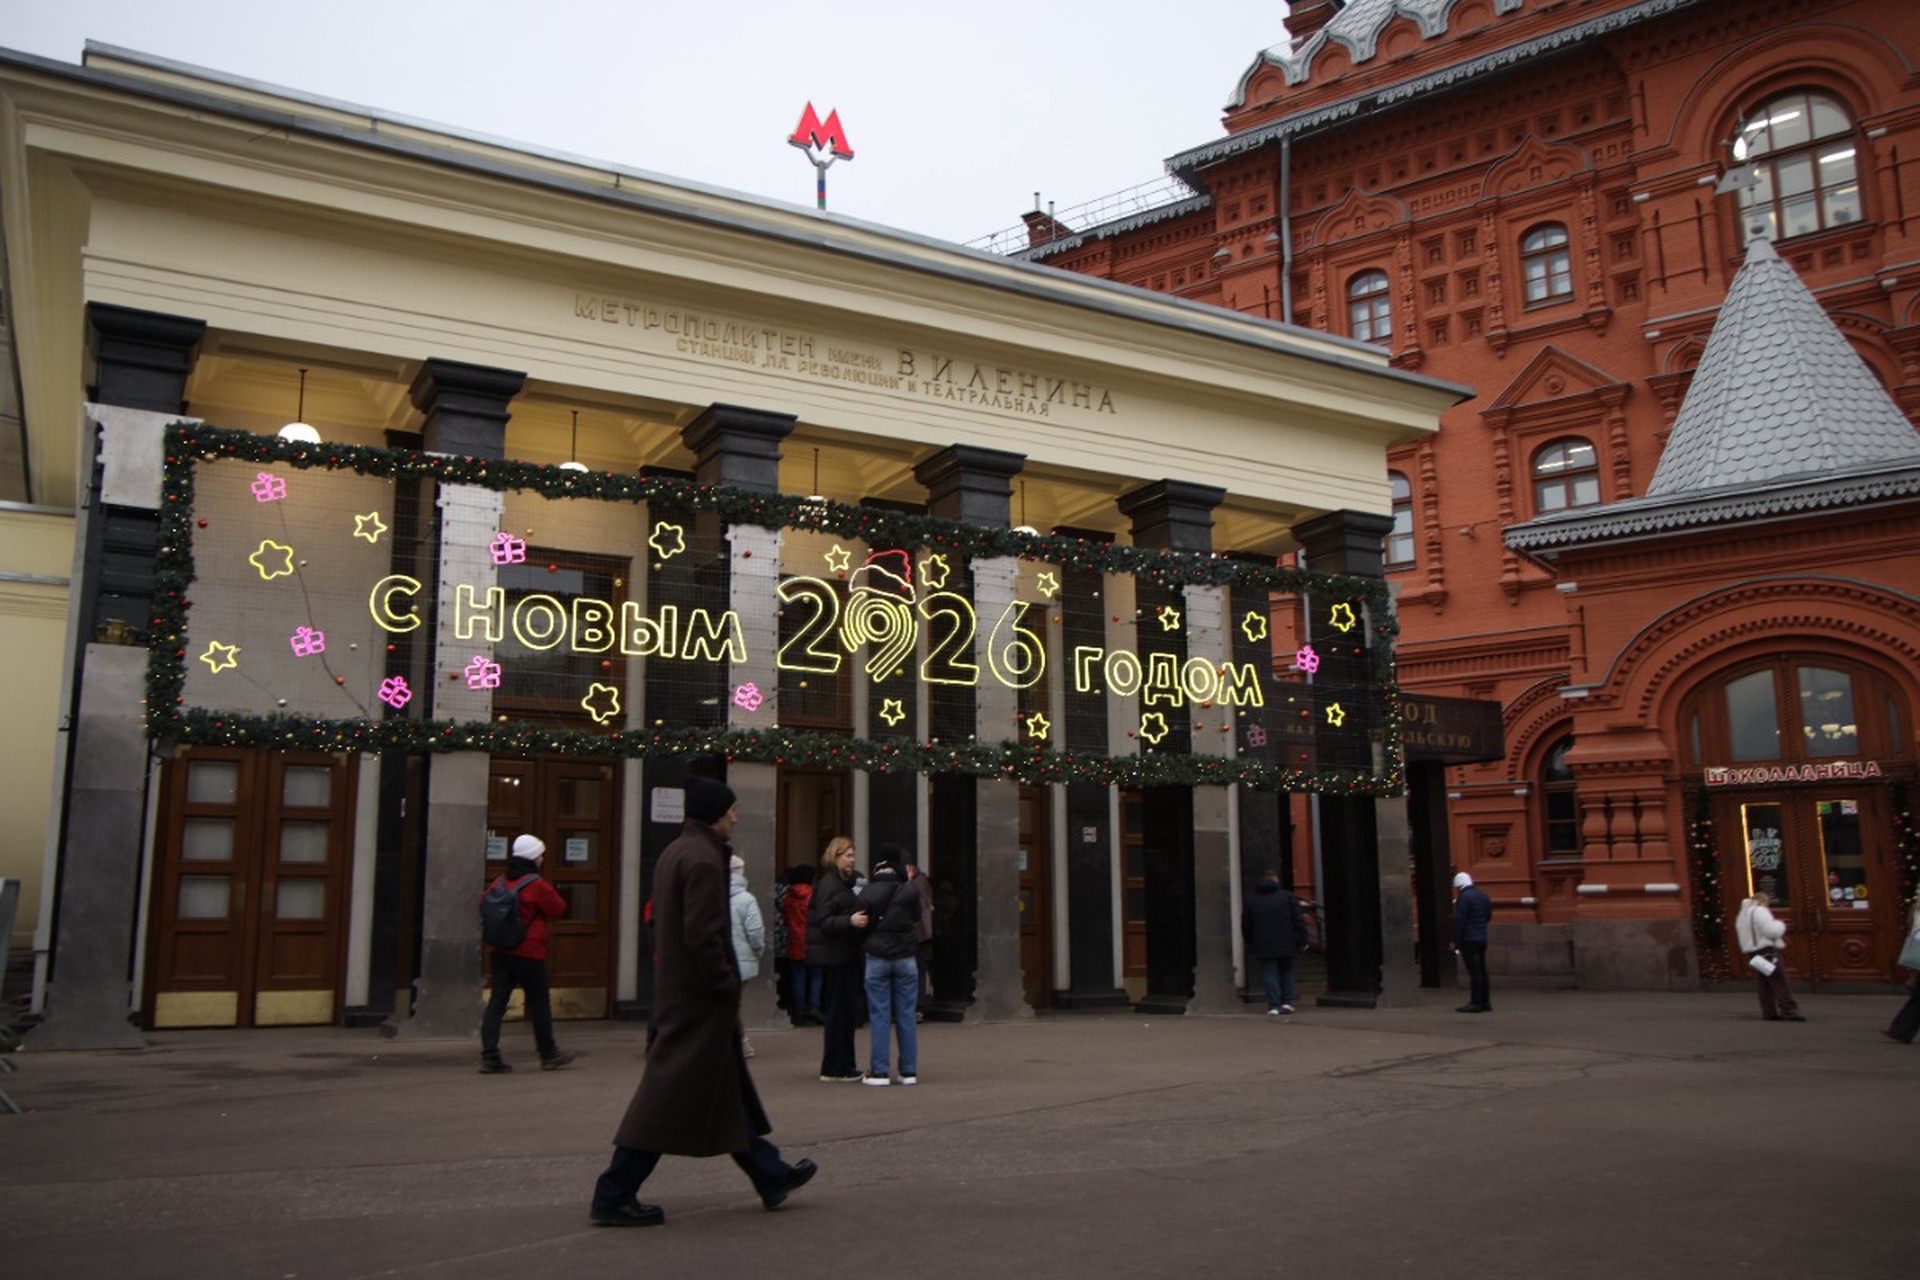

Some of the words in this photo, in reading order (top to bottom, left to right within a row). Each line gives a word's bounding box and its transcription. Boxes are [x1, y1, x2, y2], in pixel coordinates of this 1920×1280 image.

[574, 294, 816, 359] МЕТРОПОЛИТЕН
[967, 362, 1117, 415] ЛЕНИНА
[922, 380, 1049, 417] ТЕАТРАЛЬНАЯ
[369, 574, 422, 633] С
[454, 584, 748, 663] НОВЫМ
[1074, 645, 1264, 708] ГОДОМ
[1704, 761, 1881, 786] ШОКОЛАДНИЦА
